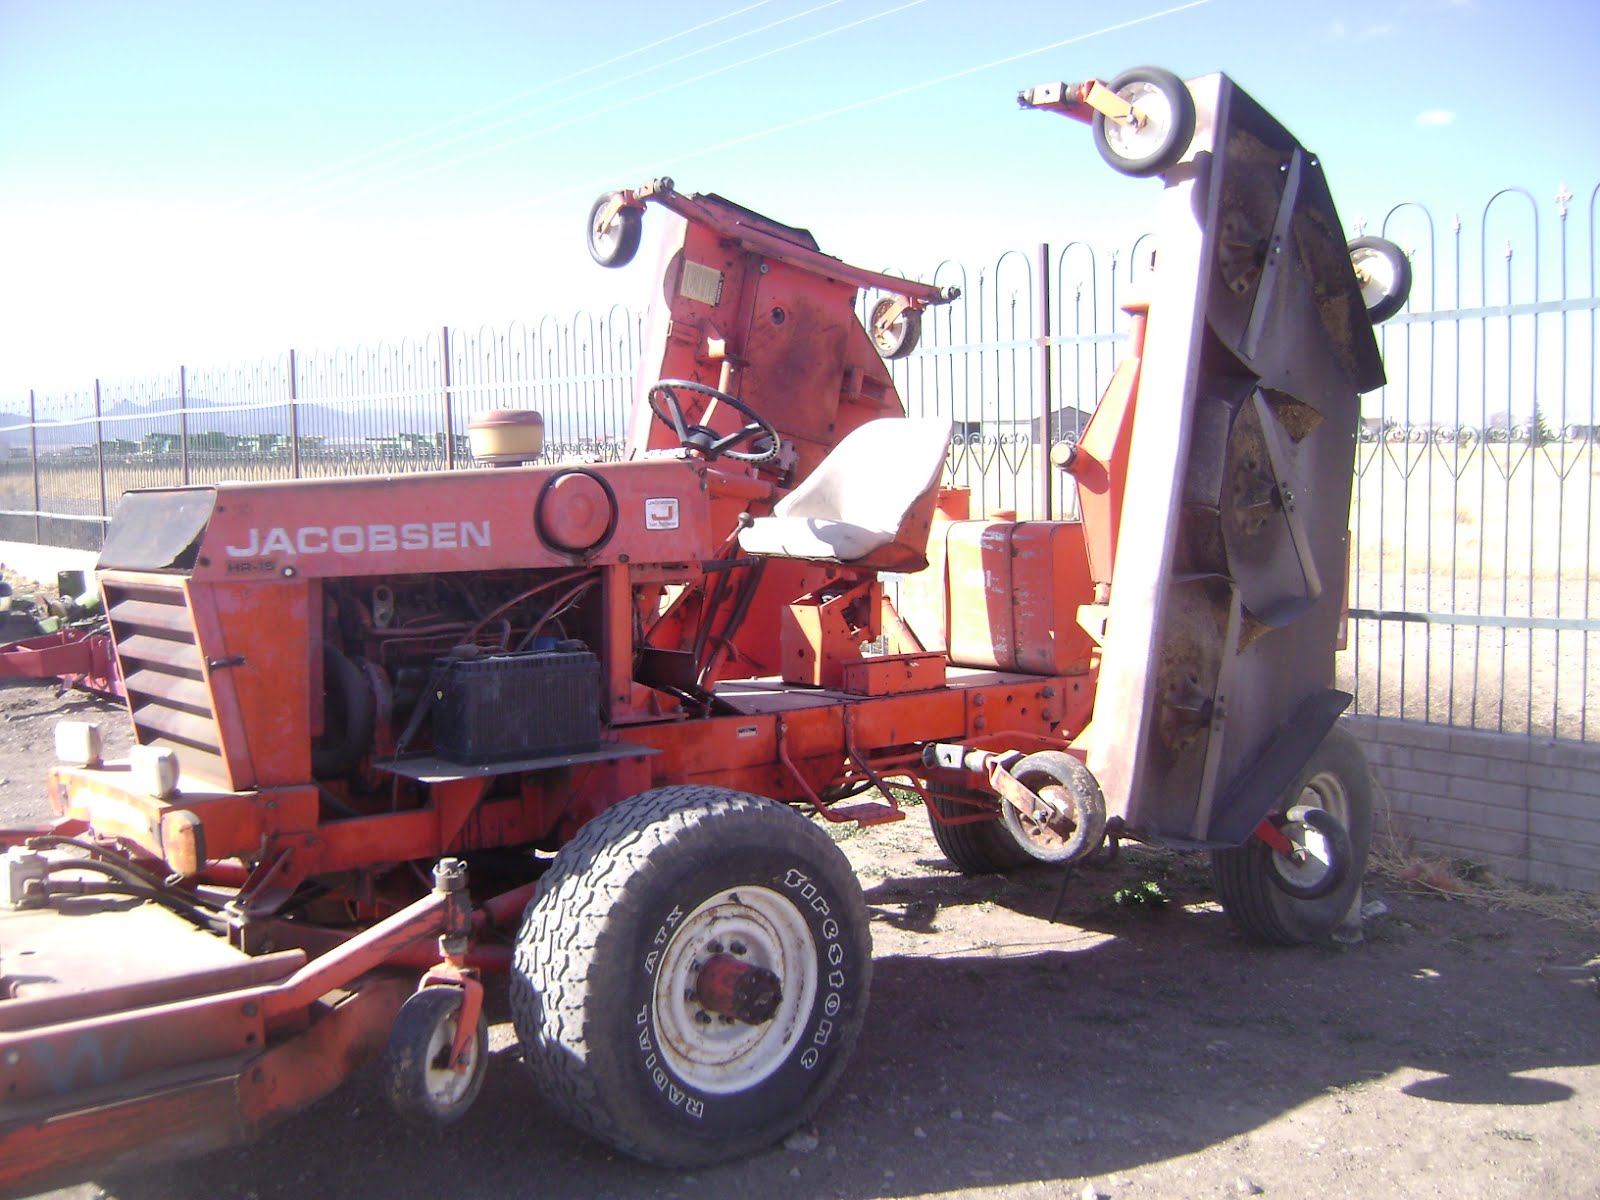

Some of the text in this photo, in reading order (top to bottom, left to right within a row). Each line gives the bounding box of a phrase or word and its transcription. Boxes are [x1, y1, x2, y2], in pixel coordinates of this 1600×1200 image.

[225, 520, 491, 557] JACOBSEN
[636, 904, 704, 1118] RADIAL ATX
